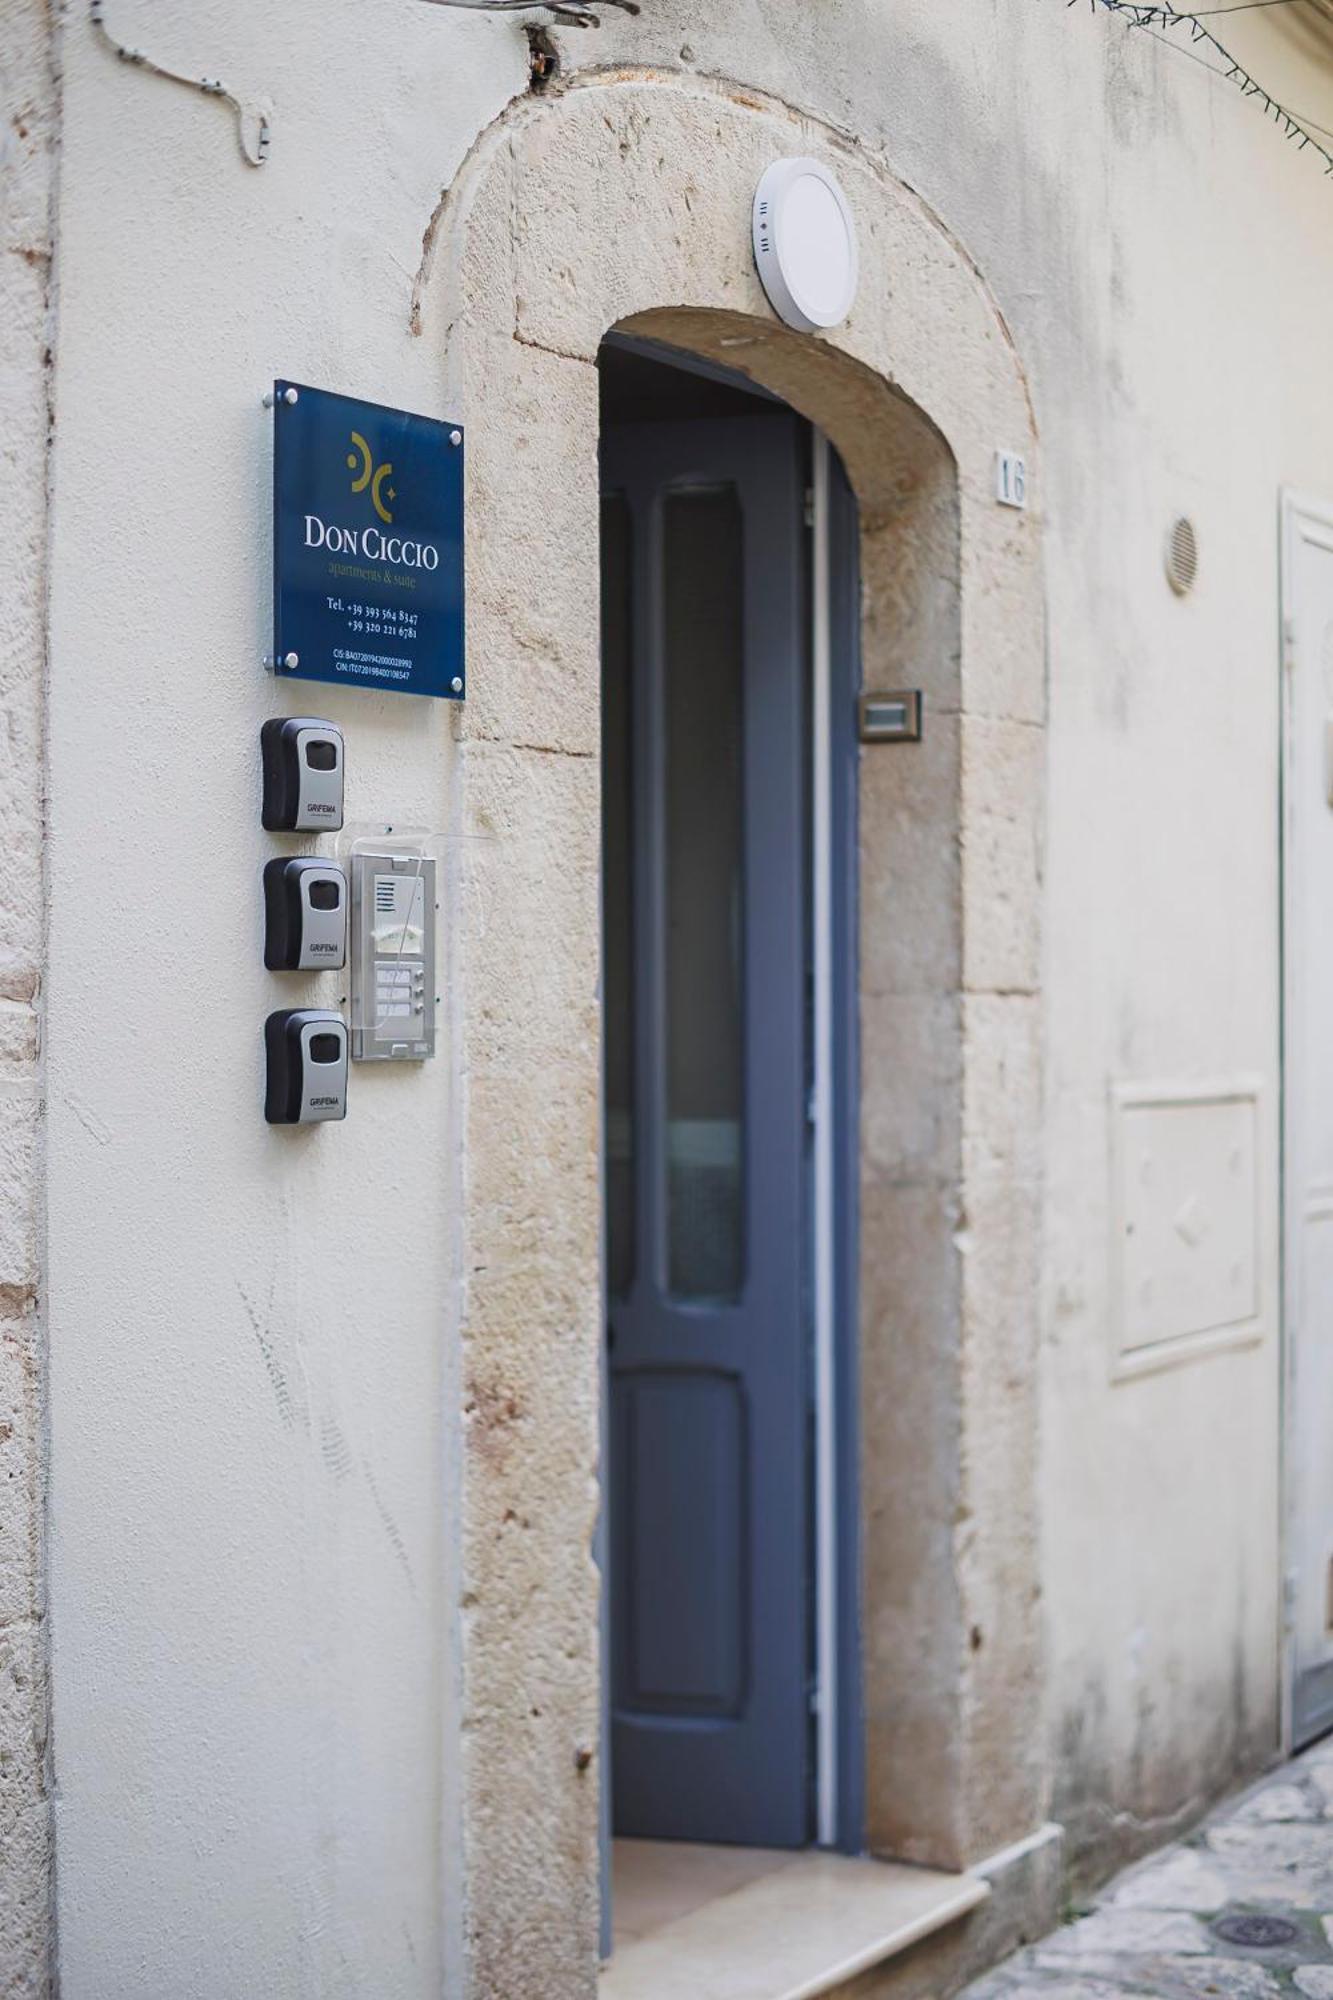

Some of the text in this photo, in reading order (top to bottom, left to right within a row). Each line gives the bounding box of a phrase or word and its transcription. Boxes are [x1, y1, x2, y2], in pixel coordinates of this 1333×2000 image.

[1003, 459, 1025, 502] 16
[383, 570, 391, 584] &
[327, 597, 418, 625] Tel. +39 393 564 8347
[348, 620, 417, 639] +39 320 221 6781
